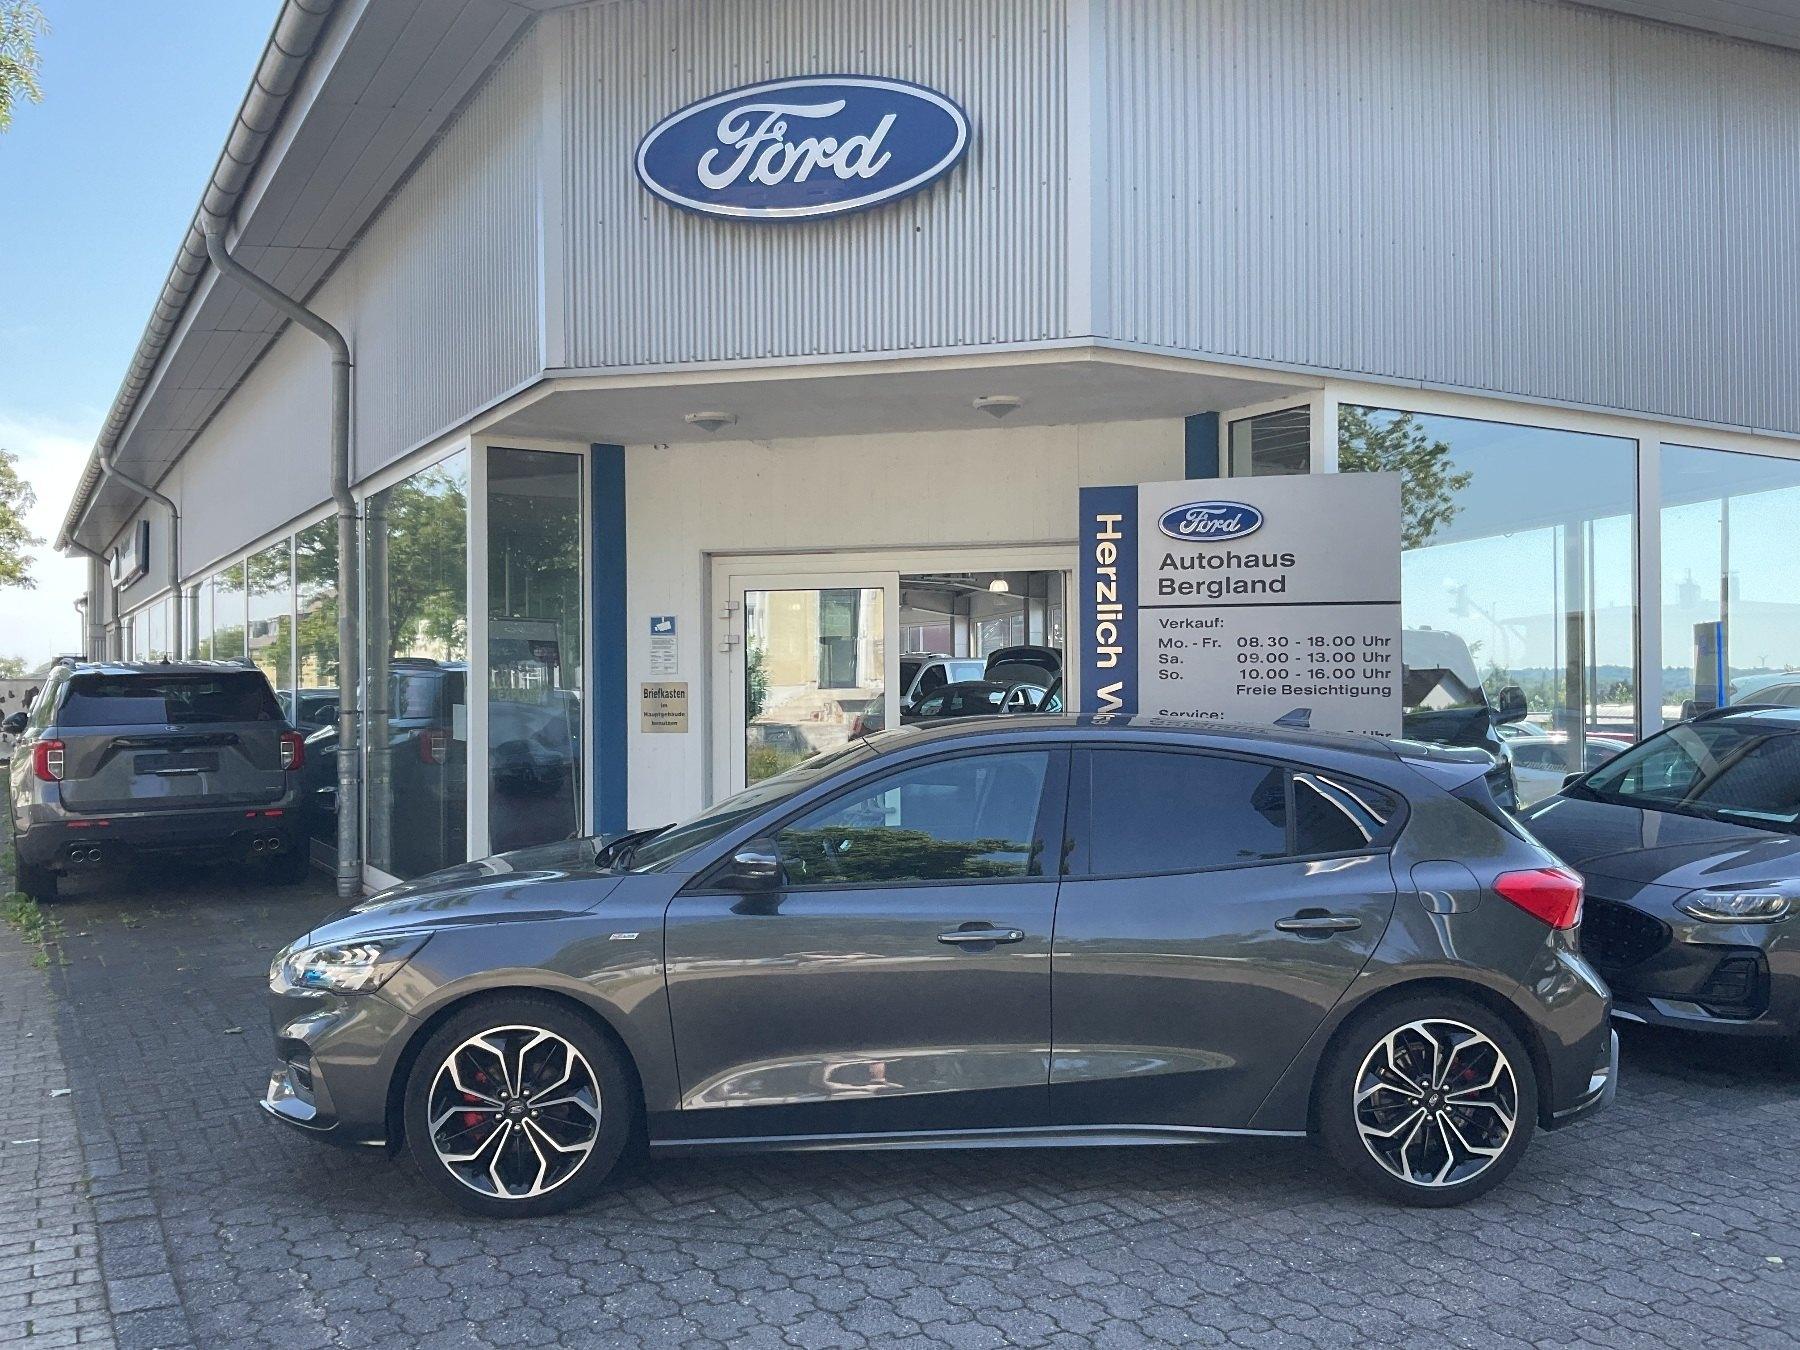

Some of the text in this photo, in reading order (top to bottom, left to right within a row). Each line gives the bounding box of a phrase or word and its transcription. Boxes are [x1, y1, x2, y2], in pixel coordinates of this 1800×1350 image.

[697, 99, 897, 190] Ford
[1179, 507, 1242, 535] Ford
[1158, 551, 1296, 571] Autohaus
[1096, 514, 1123, 668] Herzlich
[1158, 575, 1287, 599] Bergland
[1158, 617, 1224, 629] Verkauf:
[1158, 637, 1188, 649] Mo.
[1202, 637, 1222, 648] Fr.
[1236, 636, 1289, 648] 08.30
[1307, 635, 1356, 647] 18.00
[1362, 635, 1391, 647] Uhr
[1158, 653, 1184, 664] Sa.
[1236, 652, 1289, 664] 09.00
[1307, 652, 1356, 663] 13.00
[1362, 651, 1391, 663] Uhr
[1158, 669, 1184, 680] So.
[1240, 668, 1289, 680] 10.00
[1307, 668, 1356, 679] 16.00
[1362, 668, 1391, 679] Uhr
[643, 688, 685, 699] Briefkasten
[1236, 684, 1391, 698] Freie Besichtigung
